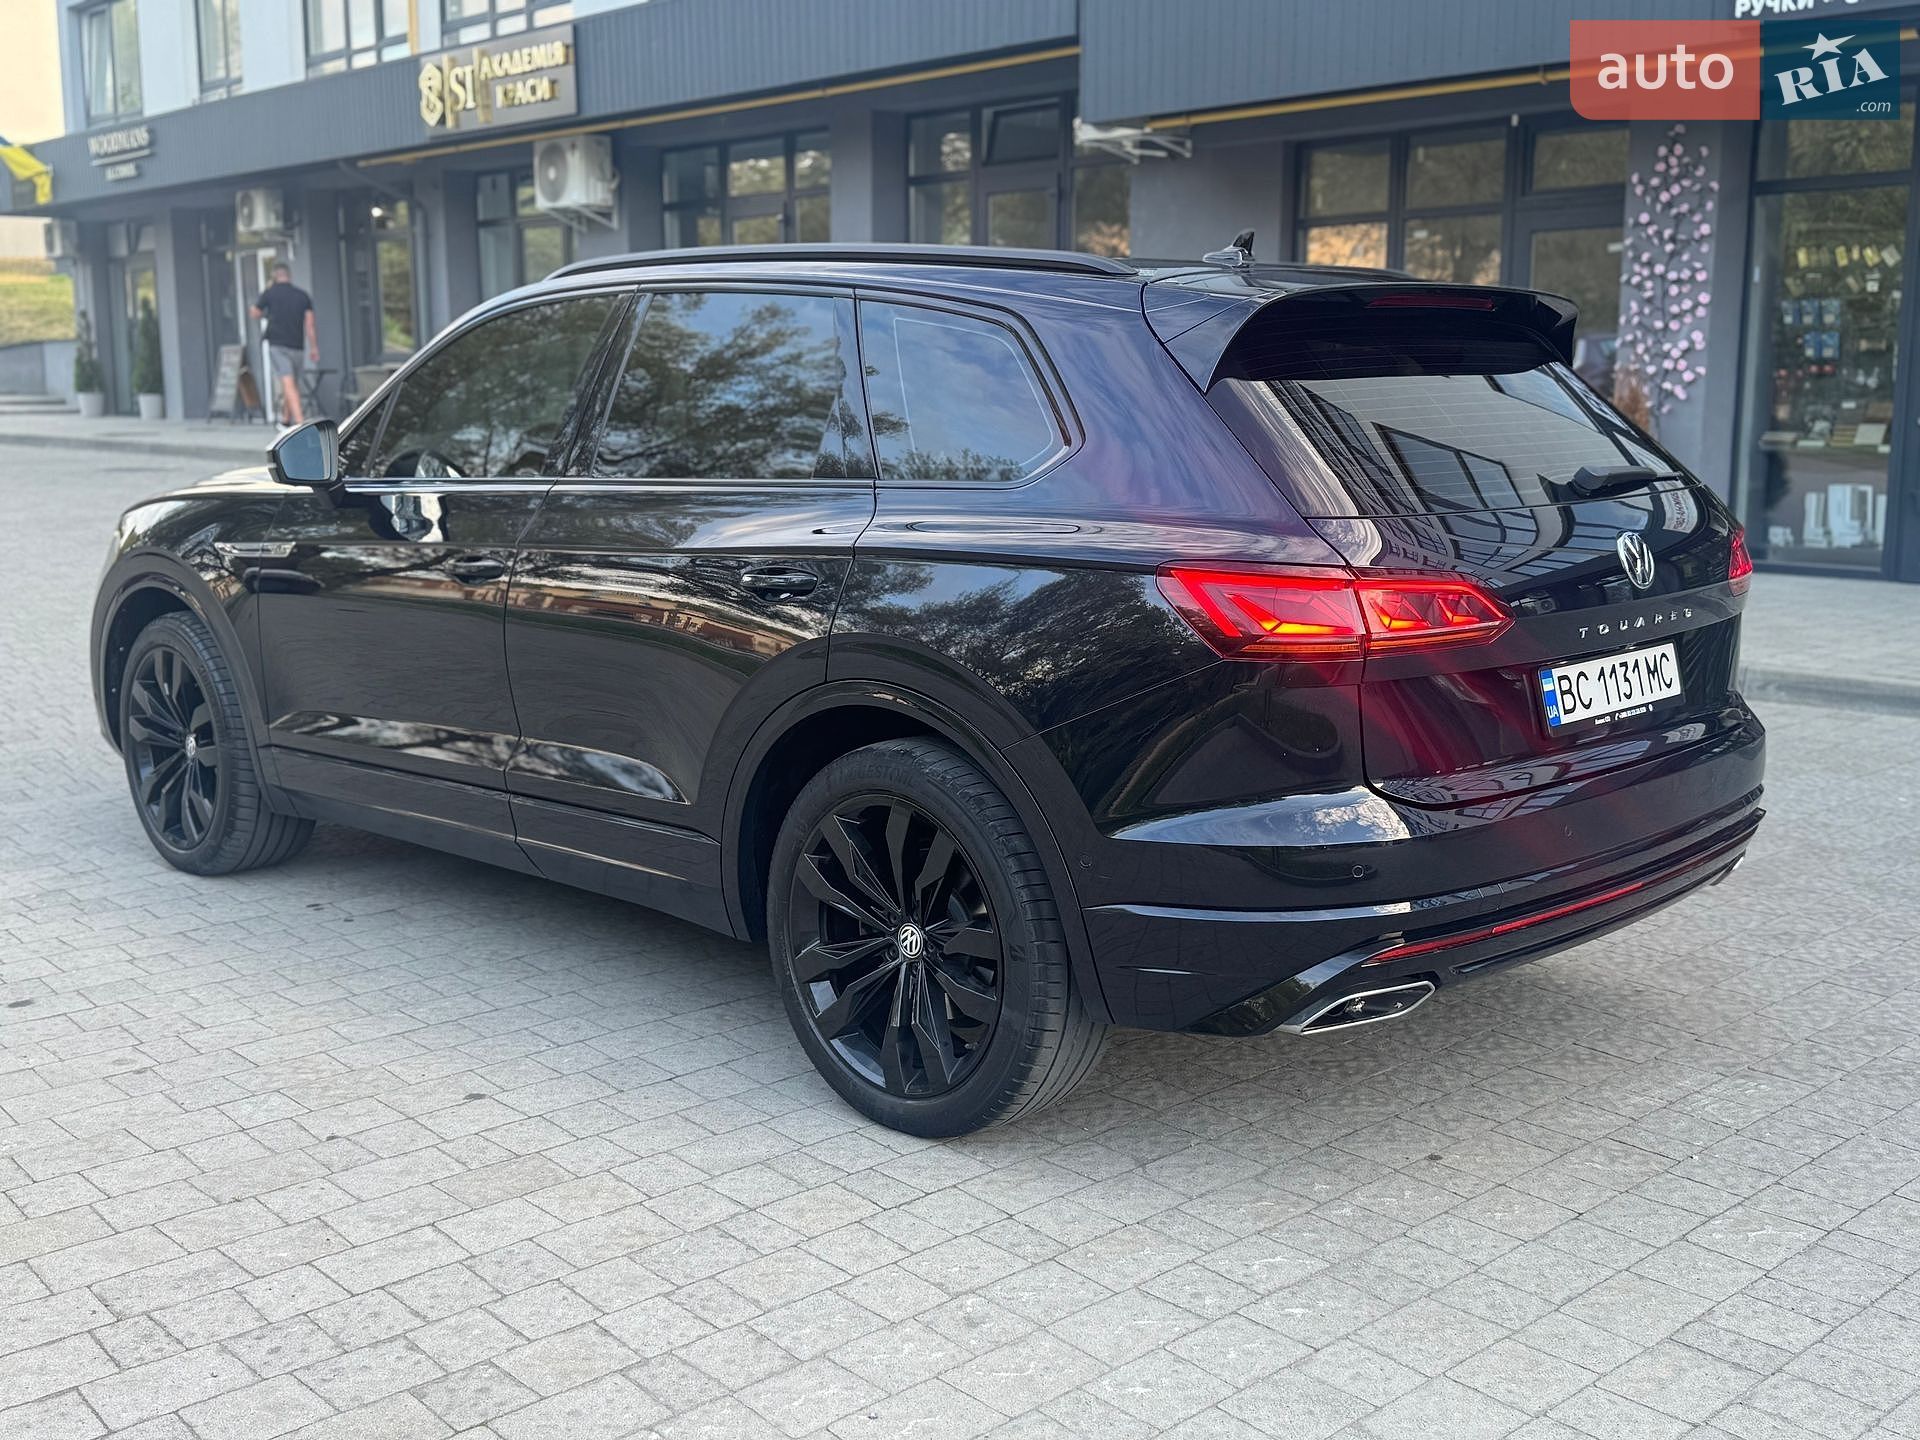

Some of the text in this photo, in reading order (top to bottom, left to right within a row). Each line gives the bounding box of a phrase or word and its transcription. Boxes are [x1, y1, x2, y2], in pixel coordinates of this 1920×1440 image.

[479, 40, 567, 80] АКАДЕМІЯ
[1579, 608, 1693, 639] TOUAREG
[1557, 671, 1592, 715] BC
[1597, 658, 1644, 705] 1131
[1644, 652, 1673, 694] MC
[1547, 705, 1559, 718] UA
